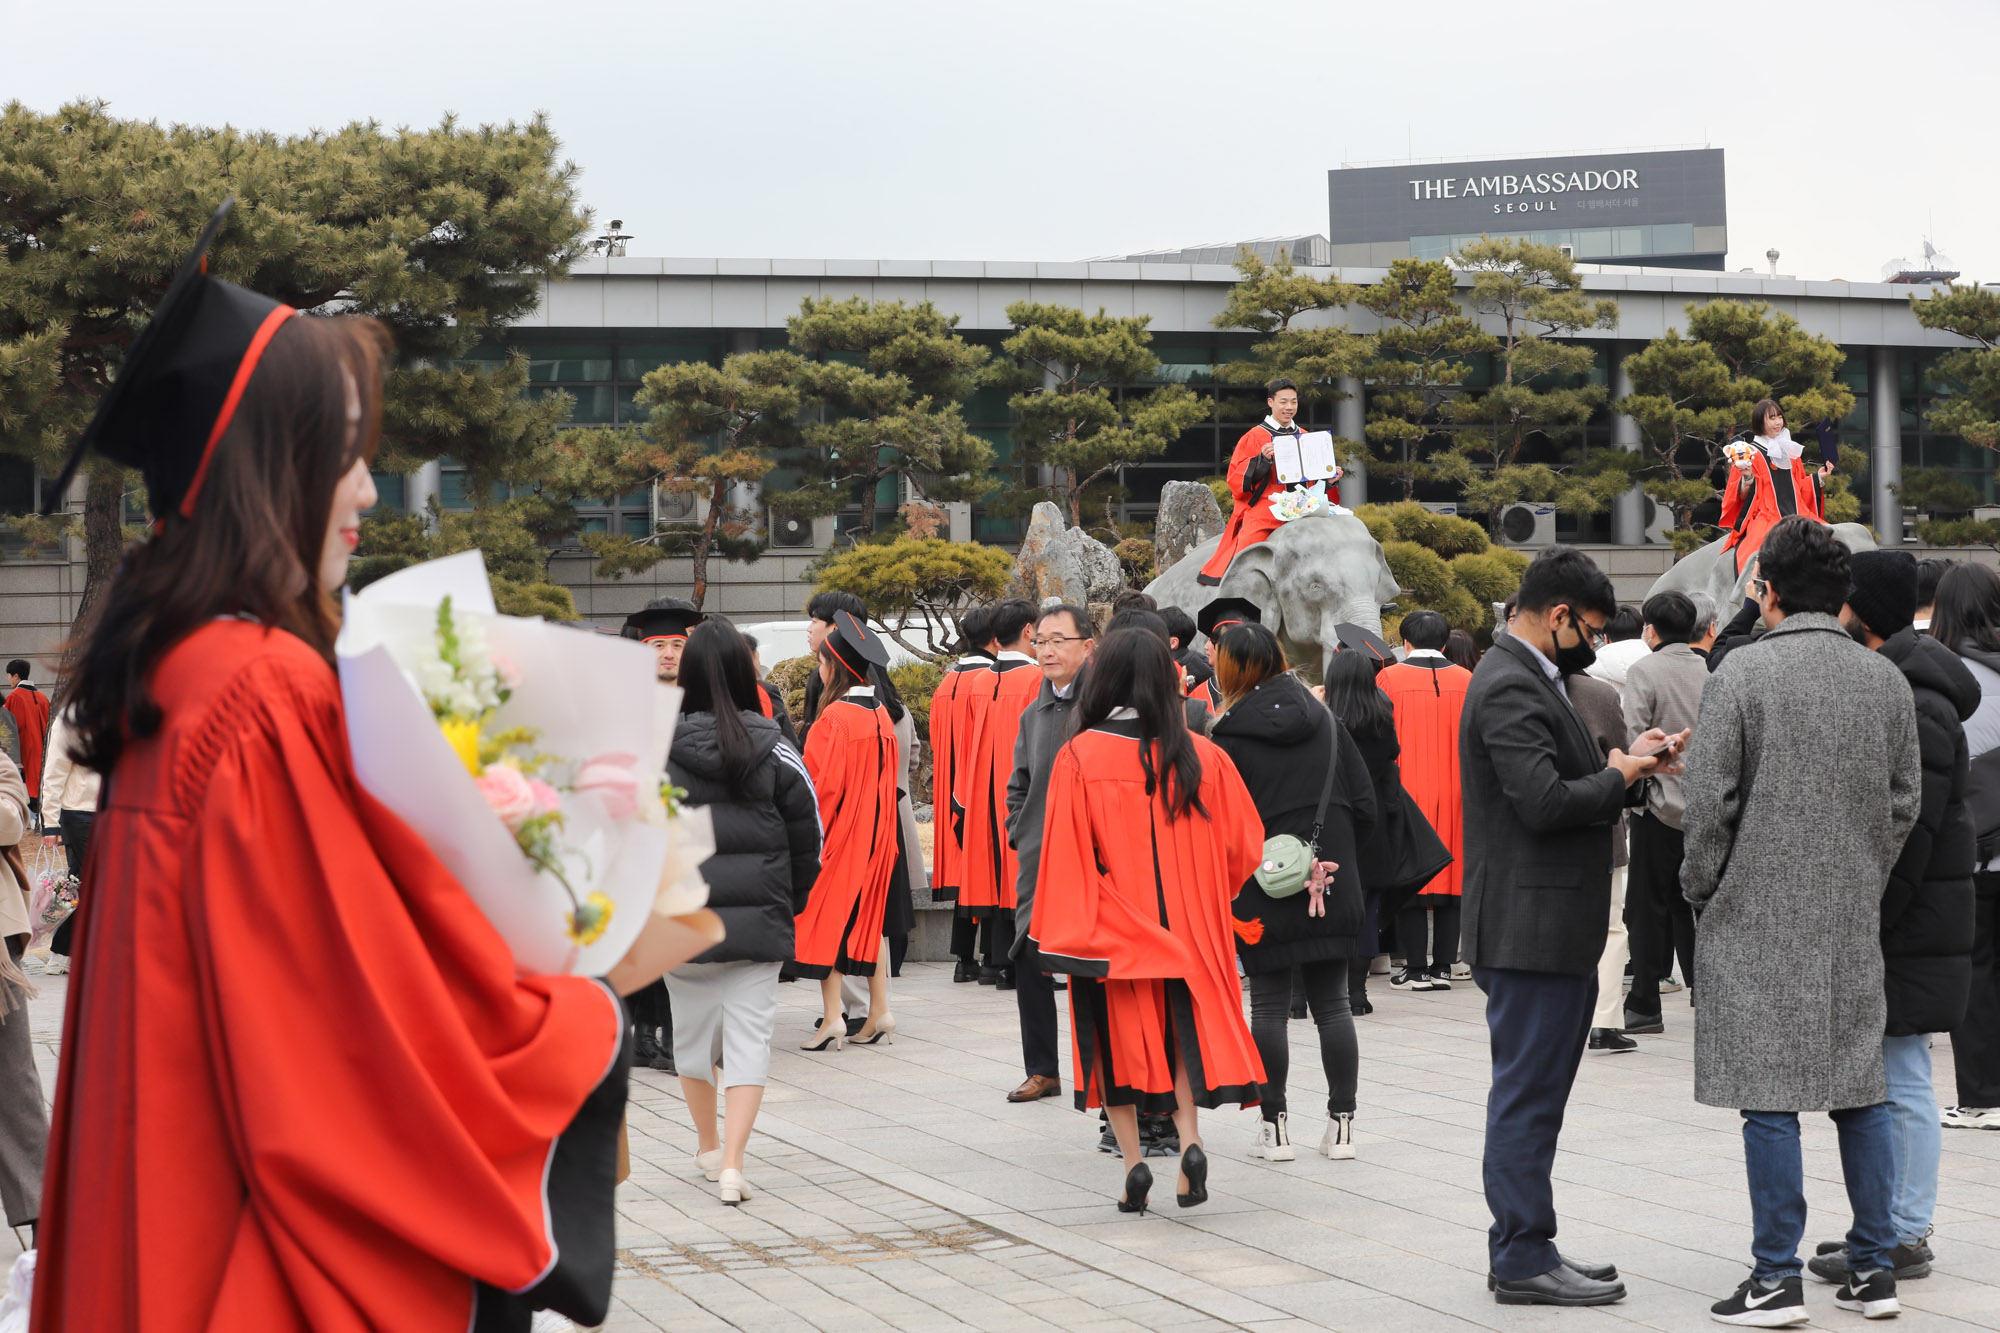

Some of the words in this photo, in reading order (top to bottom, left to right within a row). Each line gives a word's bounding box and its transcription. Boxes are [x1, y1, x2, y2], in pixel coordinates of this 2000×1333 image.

[1409, 178, 1457, 200] THE
[1463, 169, 1639, 197] AMBASSADOR
[1494, 201, 1557, 214] SEOUL
[1622, 197, 1639, 207] 서울
